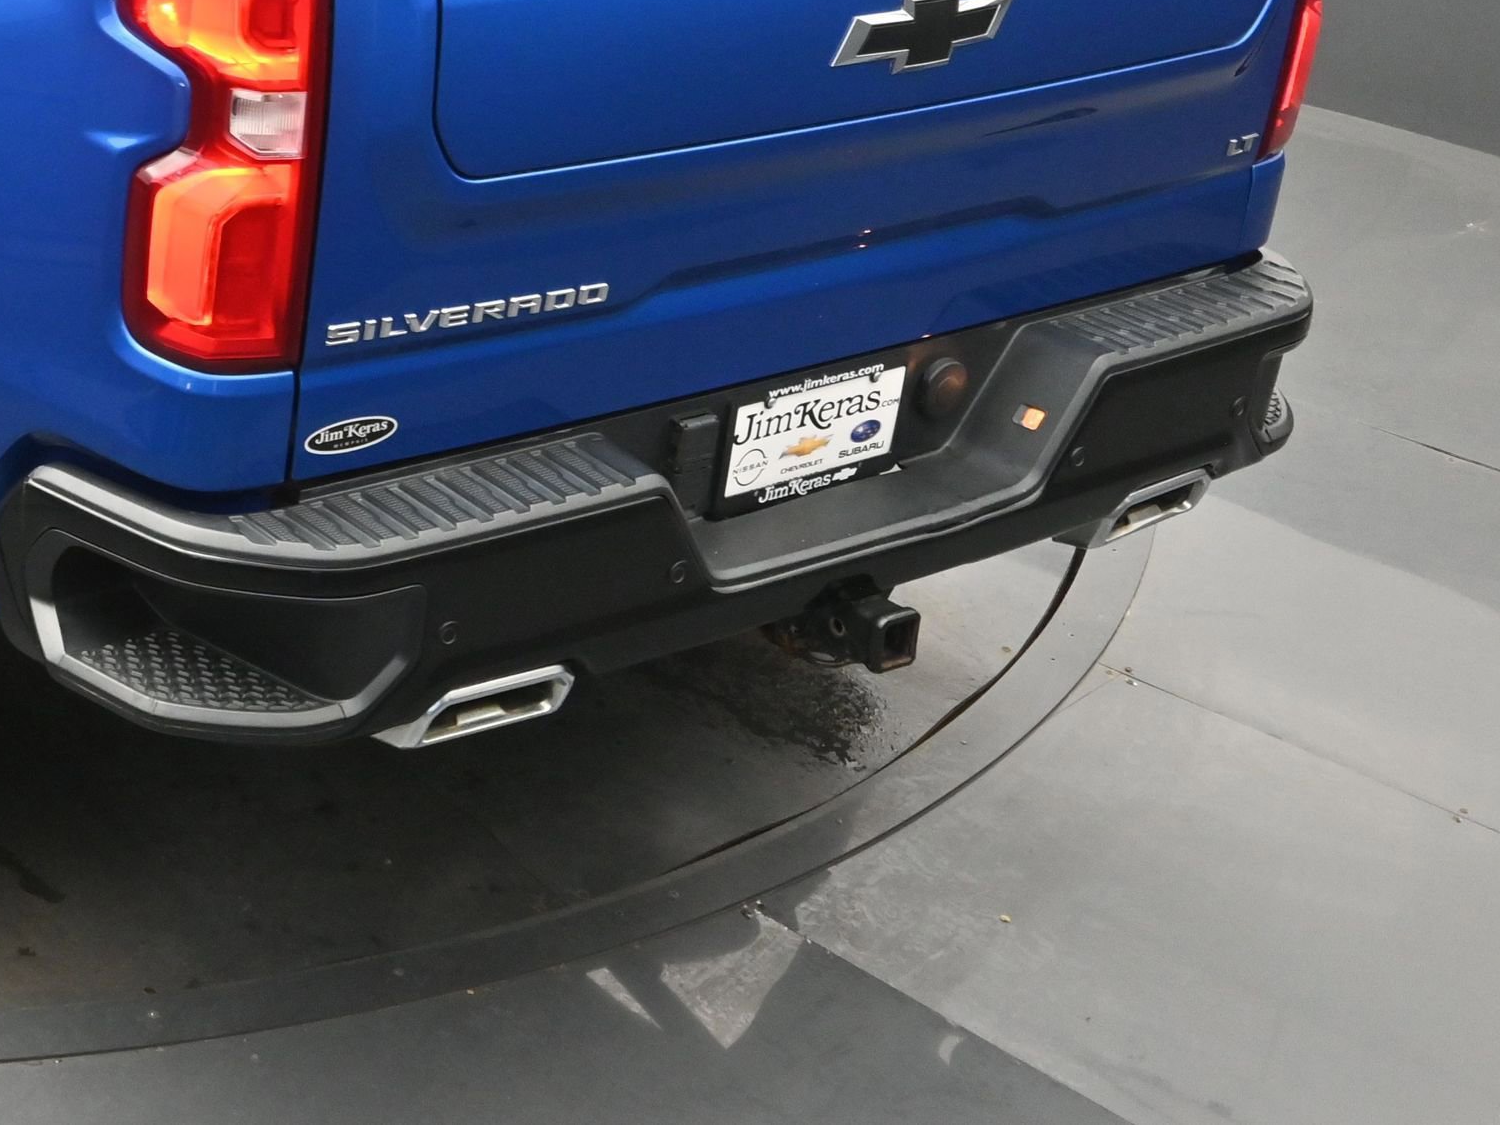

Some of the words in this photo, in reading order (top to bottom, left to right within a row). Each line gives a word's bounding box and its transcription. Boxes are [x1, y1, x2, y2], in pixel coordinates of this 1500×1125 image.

[1226, 133, 1259, 156] LT
[325, 282, 609, 346] SILVERADO
[768, 363, 884, 398] www.jimkeras.com
[838, 441, 884, 459] SUBARU
[732, 460, 769, 475] NISSAN
[780, 458, 824, 475] CHEVROLET
